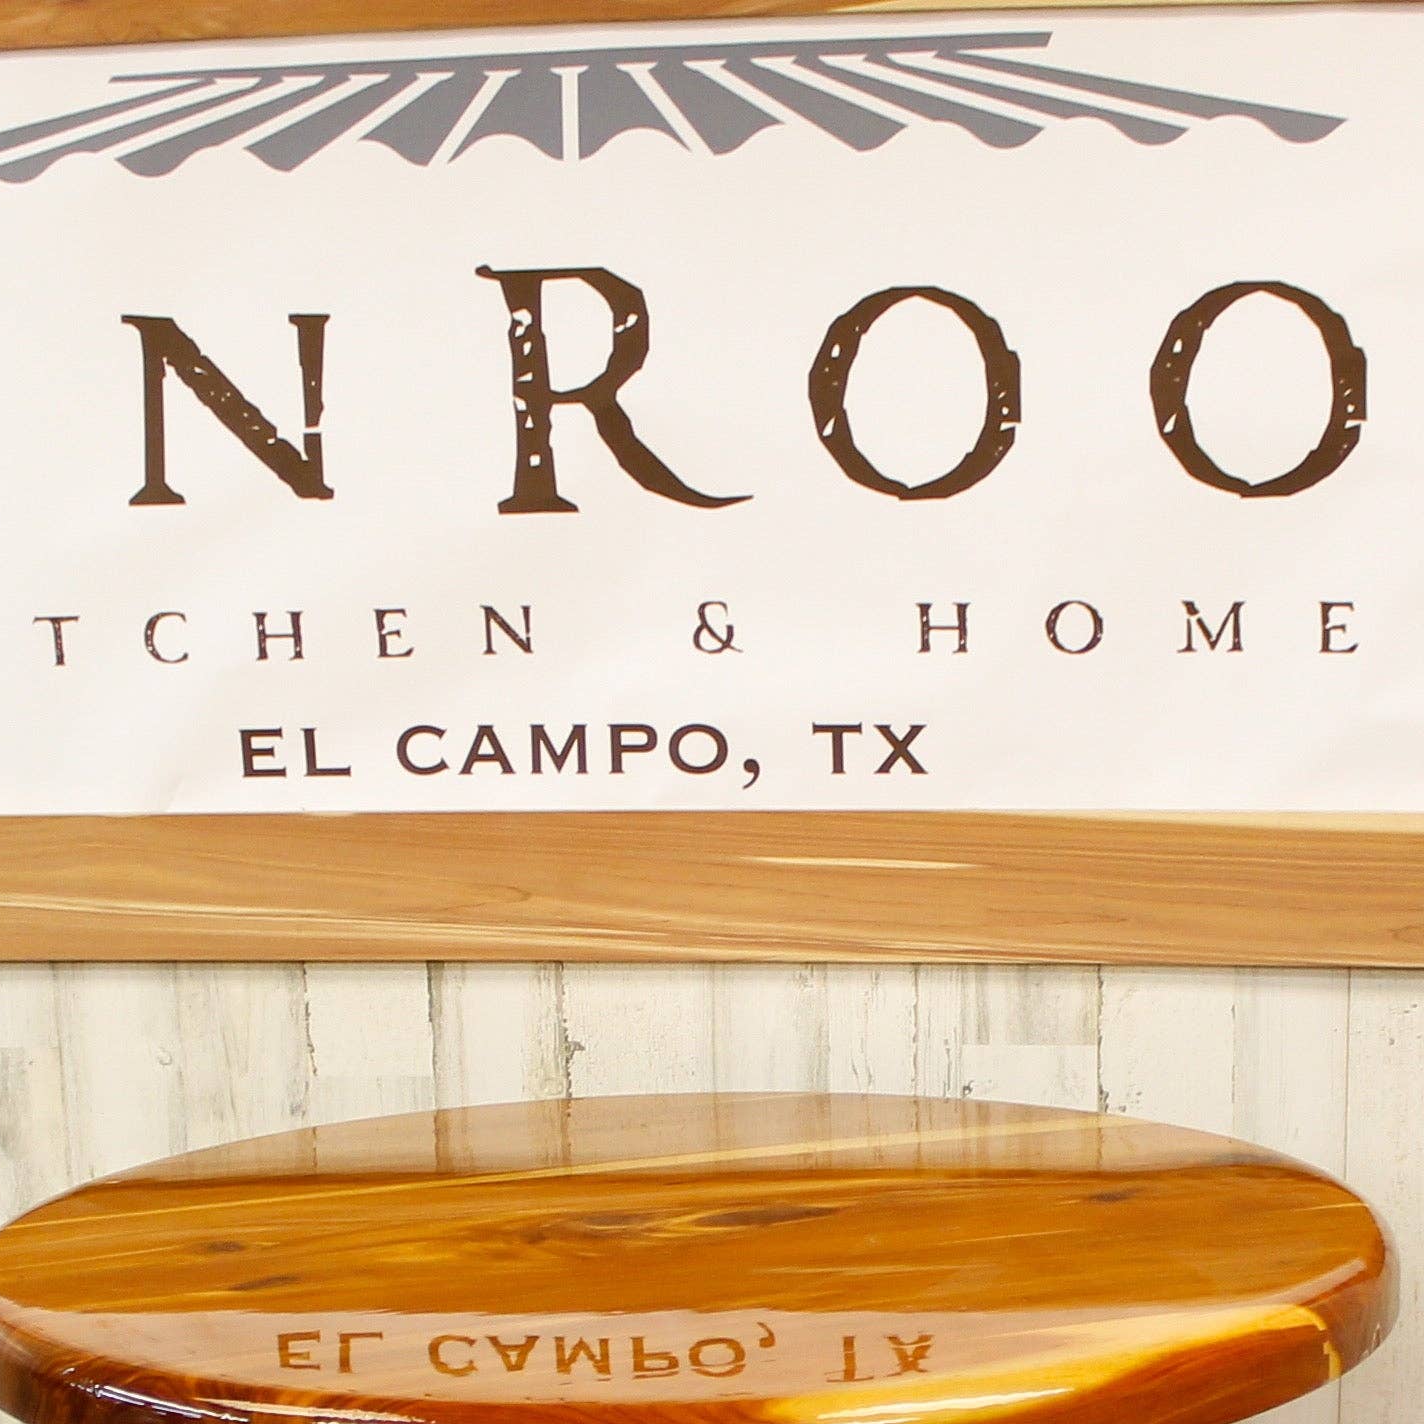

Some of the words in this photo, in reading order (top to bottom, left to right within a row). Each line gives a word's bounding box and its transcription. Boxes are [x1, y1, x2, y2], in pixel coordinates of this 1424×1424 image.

[692, 600, 744, 654] &
[916, 600, 1358, 655] HOME
[238, 727, 352, 778] EL
[395, 723, 761, 789] CAMPO,
[811, 722, 928, 775] TX
